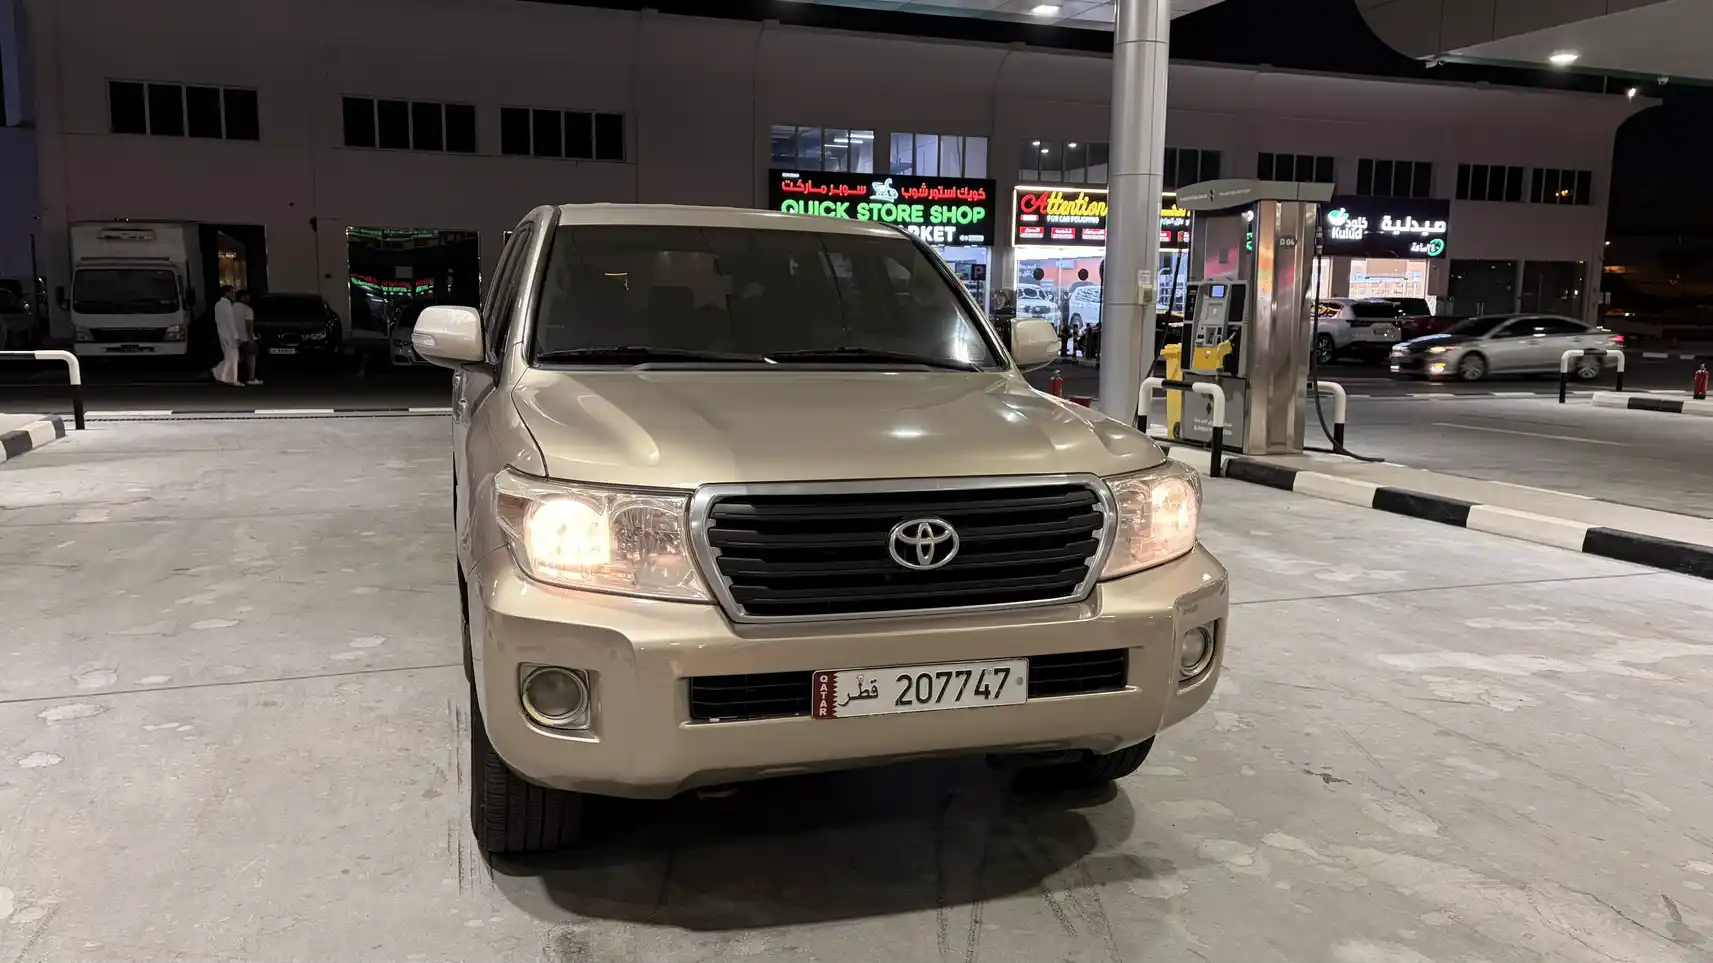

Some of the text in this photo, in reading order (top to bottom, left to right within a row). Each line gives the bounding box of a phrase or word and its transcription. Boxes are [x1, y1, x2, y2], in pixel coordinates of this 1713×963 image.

[781, 179, 828, 194] ماركت
[901, 182, 986, 201] كويك استور شوب
[781, 199, 986, 225] QUICK STORE SHOP
[1021, 191, 1108, 216] Attention
[1346, 216, 1368, 229] خلود
[1381, 215, 1447, 236] صيدلية
[1279, 238, 1286, 246] D
[819, 675, 829, 717] QATAR
[838, 676, 879, 706] قطر
[894, 667, 1011, 706] 207747
